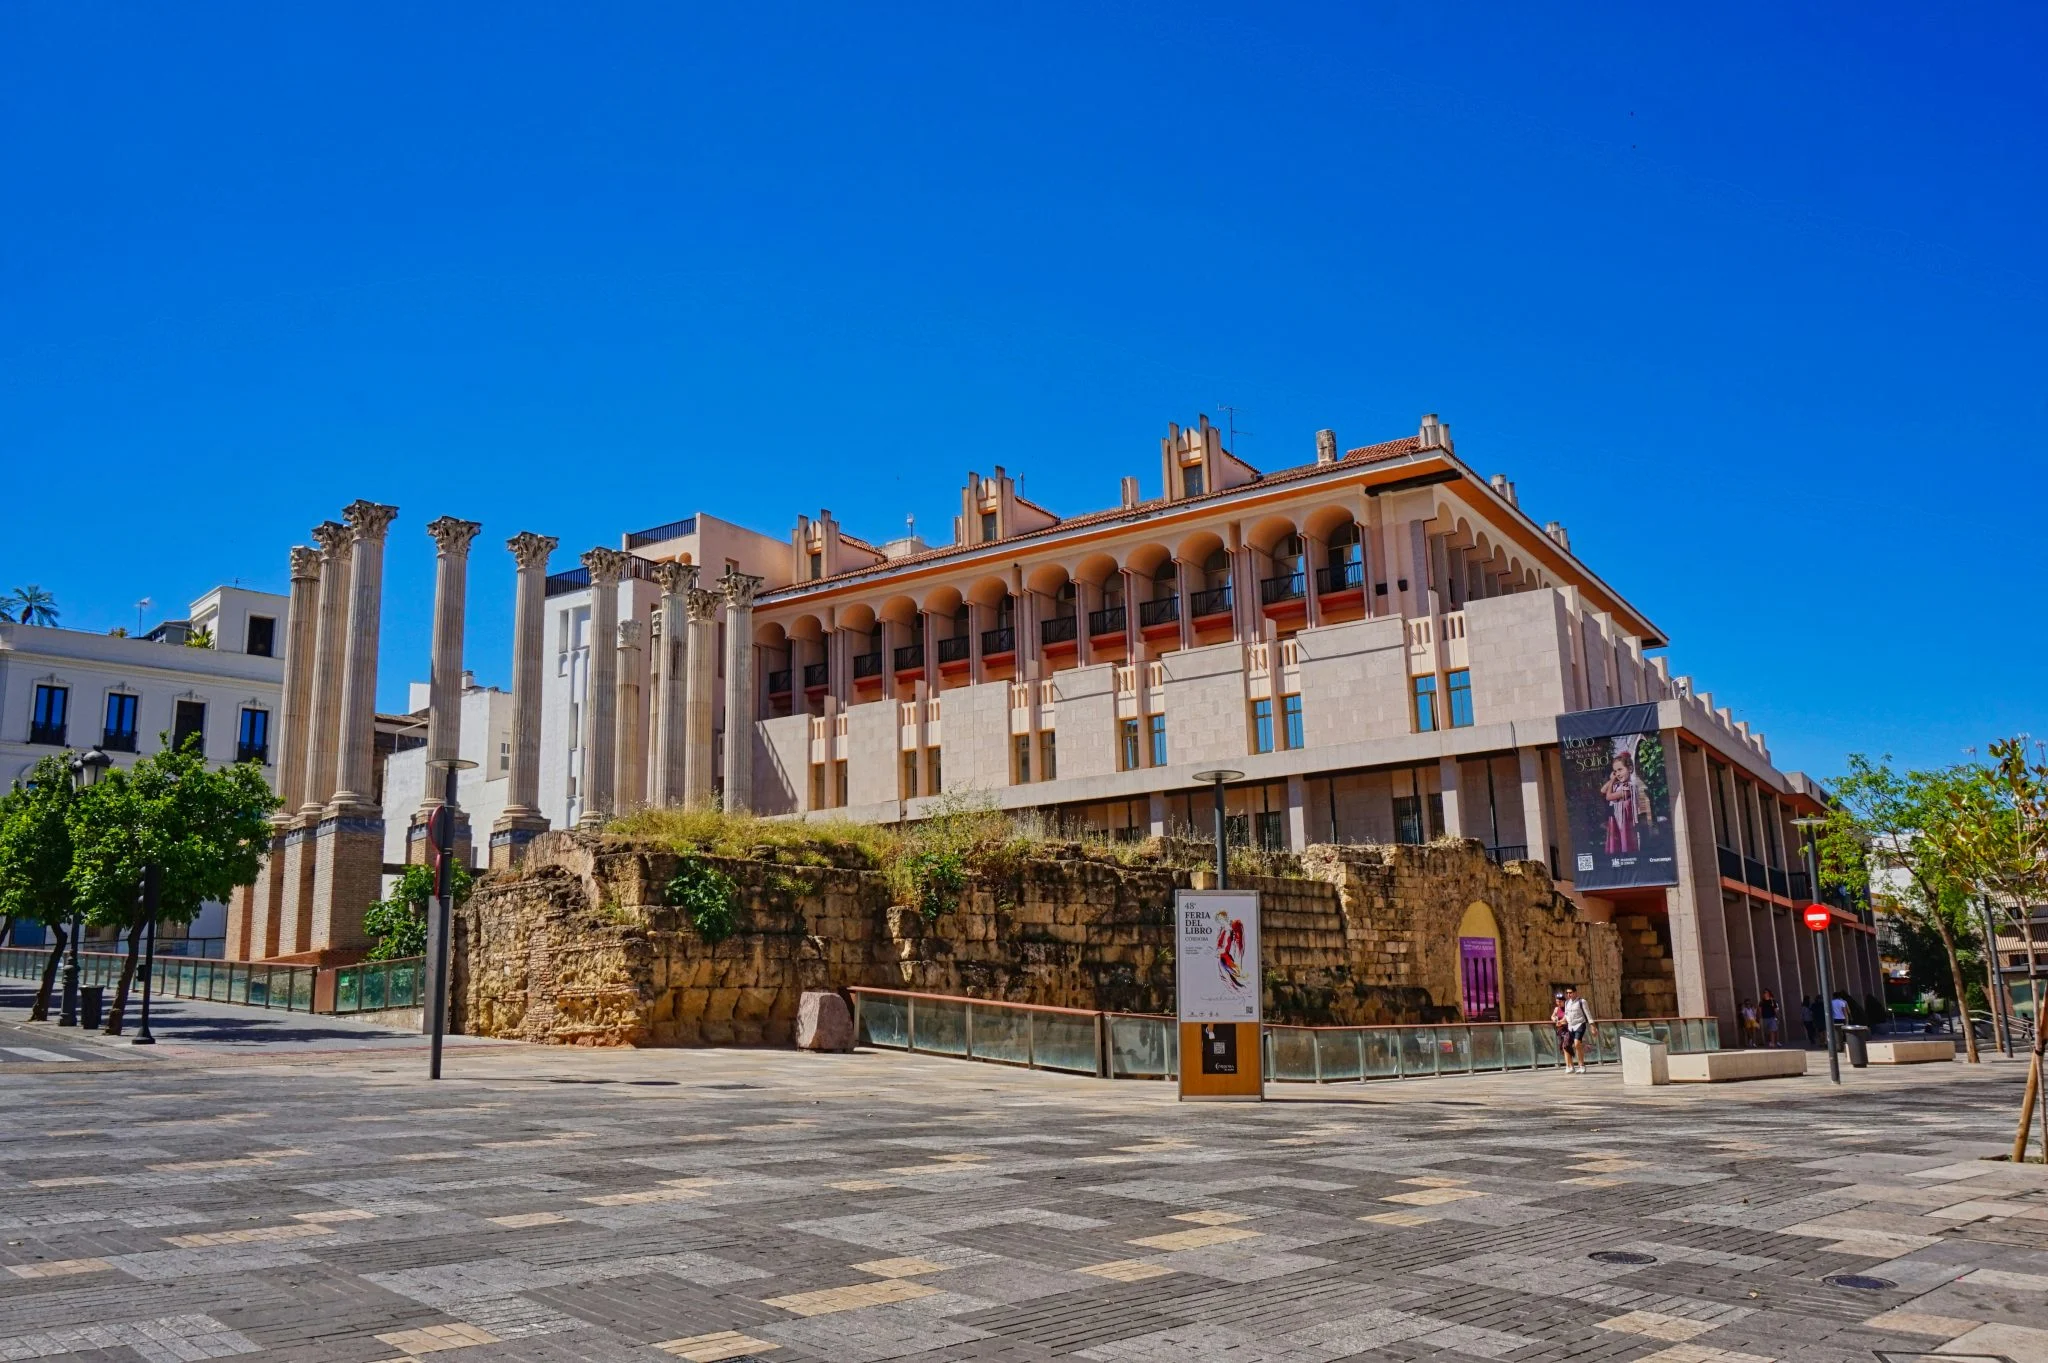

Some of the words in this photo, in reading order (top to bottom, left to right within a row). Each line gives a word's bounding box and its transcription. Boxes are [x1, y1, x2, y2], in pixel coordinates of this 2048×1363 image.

[1185, 911, 1211, 919] FERIA
[1185, 919, 1203, 927] DEL
[1185, 926, 1213, 935] LIBRO
